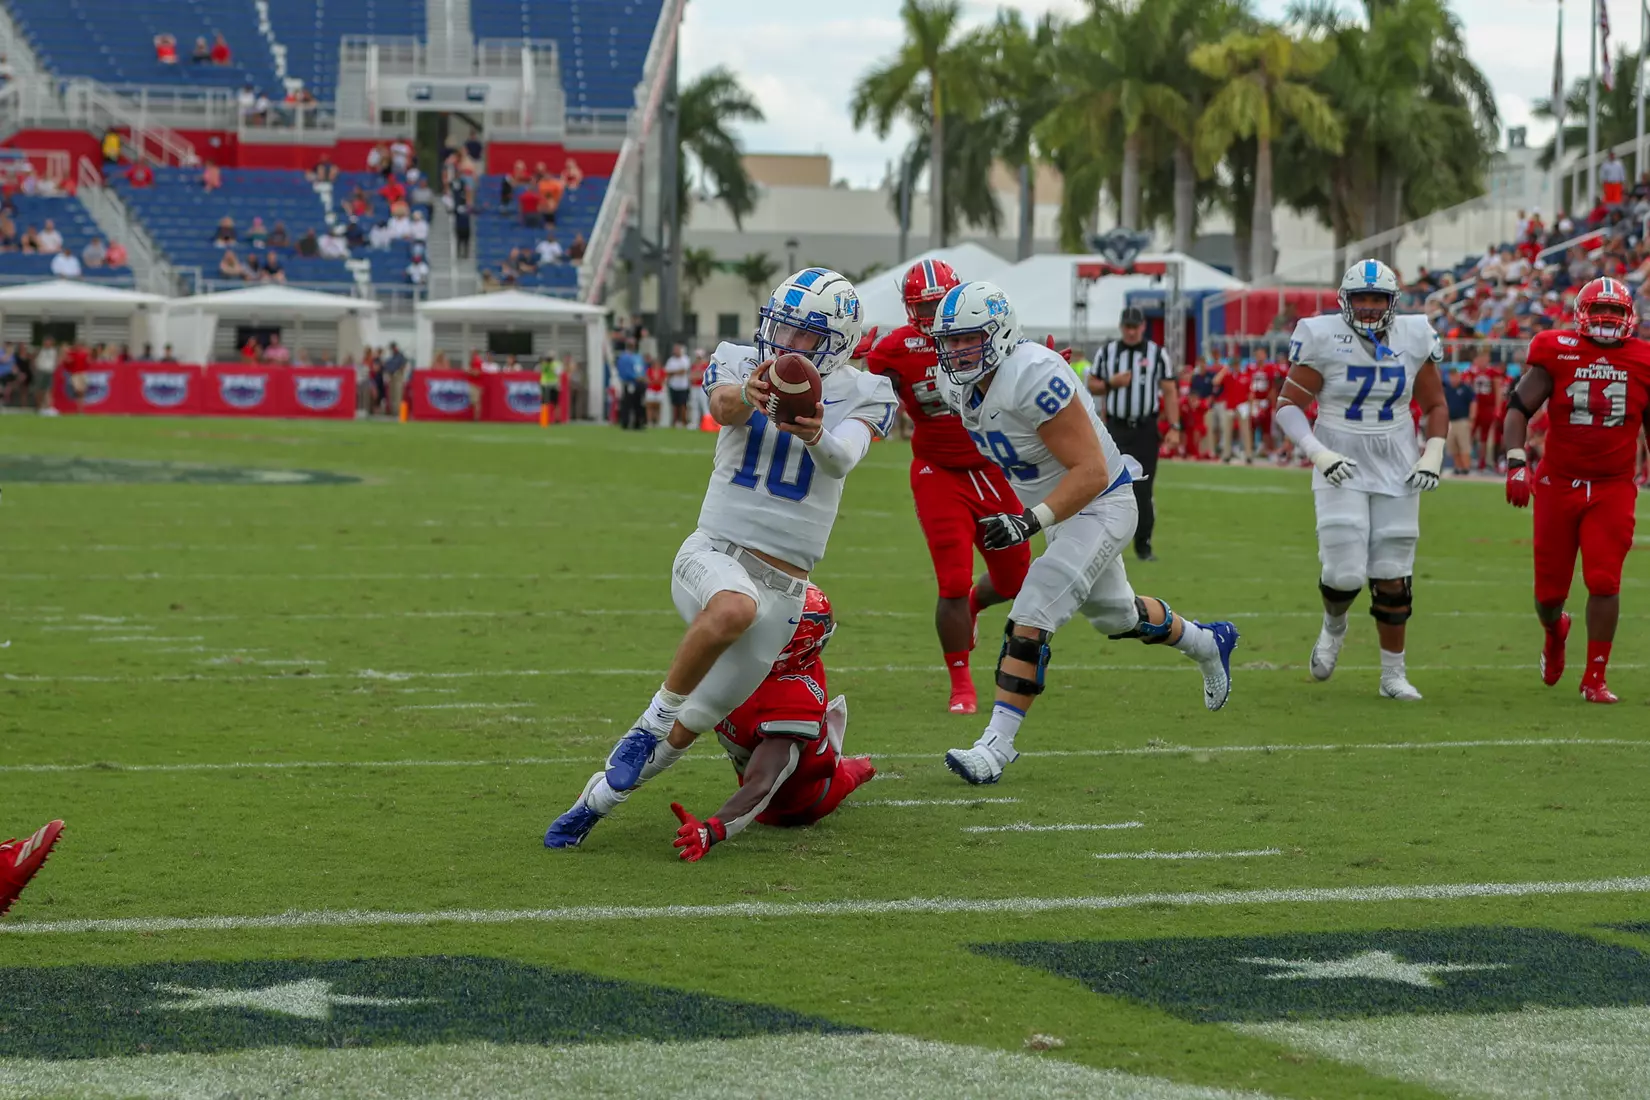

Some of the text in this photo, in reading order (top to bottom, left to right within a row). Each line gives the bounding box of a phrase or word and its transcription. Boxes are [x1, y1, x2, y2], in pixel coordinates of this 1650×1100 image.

[1574, 367, 1628, 381] ATLANTIC
[1588, 363, 1614, 372] FLORIDA
[1035, 376, 1071, 415] 68
[1345, 365, 1406, 422] 77
[1565, 381, 1627, 428] 11
[729, 409, 816, 503] 10
[1070, 540, 1115, 606] RIDERS
